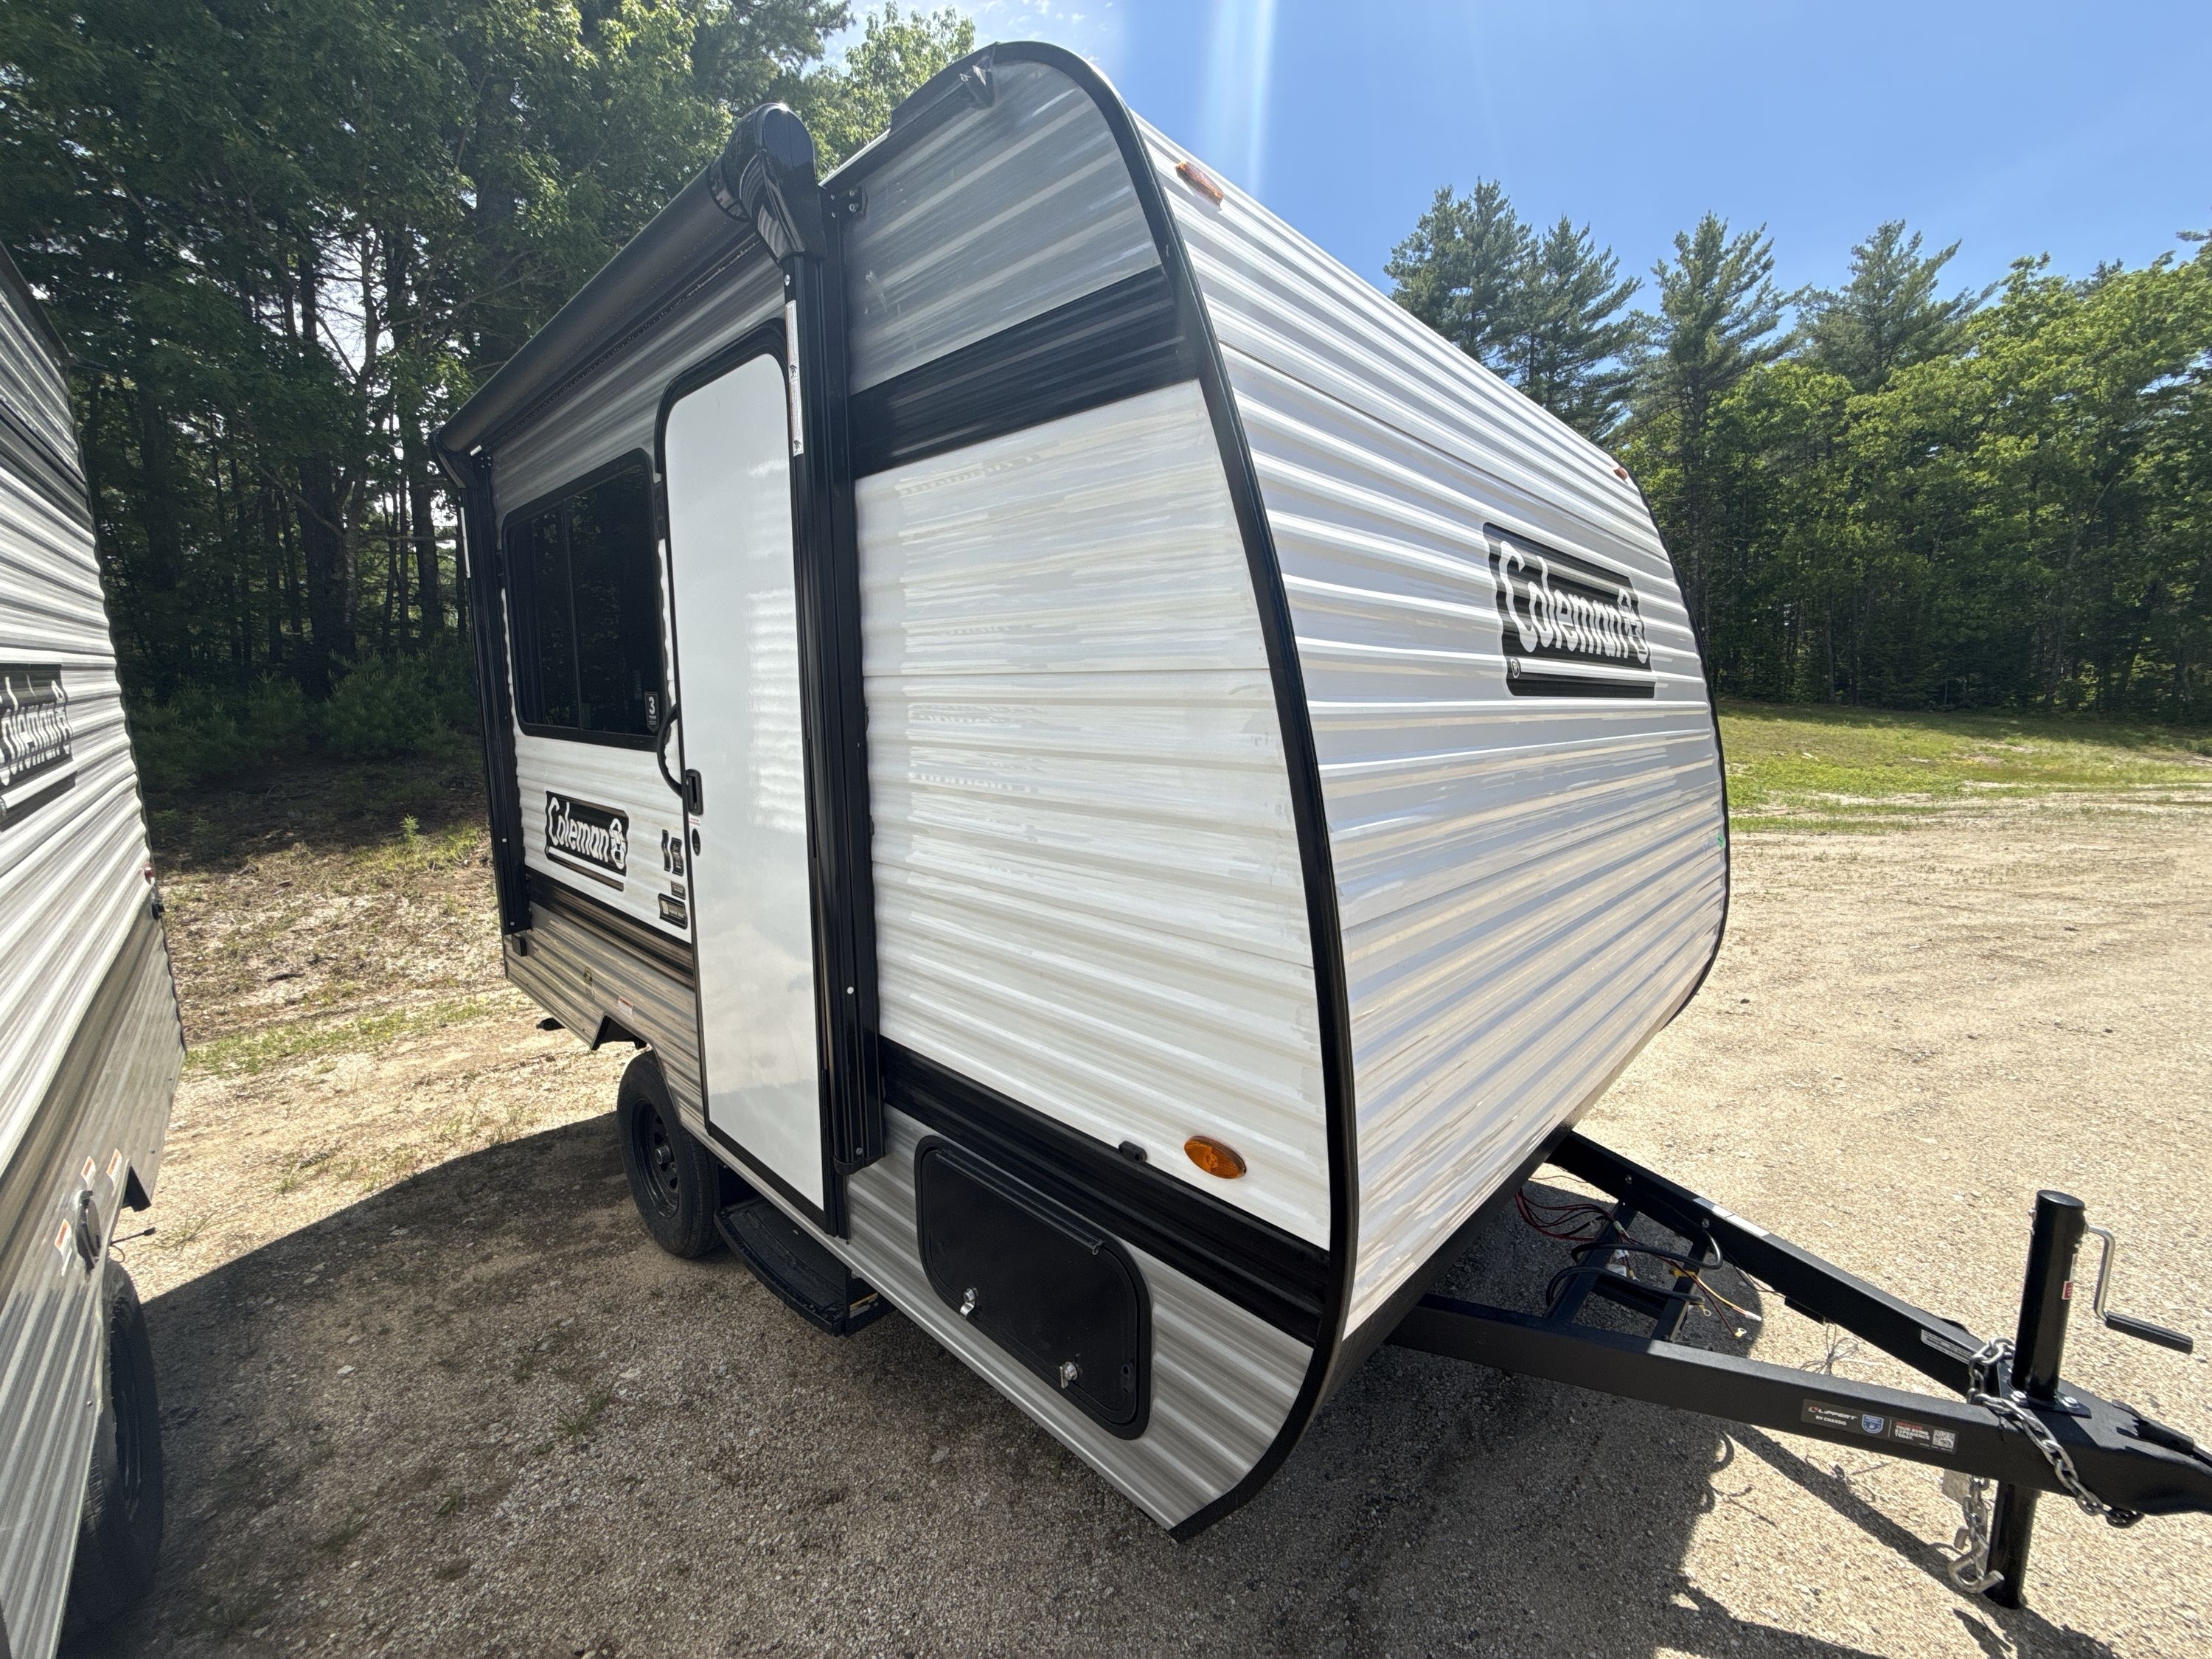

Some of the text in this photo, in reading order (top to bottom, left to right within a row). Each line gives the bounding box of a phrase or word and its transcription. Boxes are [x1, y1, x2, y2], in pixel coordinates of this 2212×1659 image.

[1498, 540, 1629, 658] Coleman
[0, 675, 62, 786] oleman
[649, 696, 655, 714] 3
[548, 797, 609, 863] Coleman
